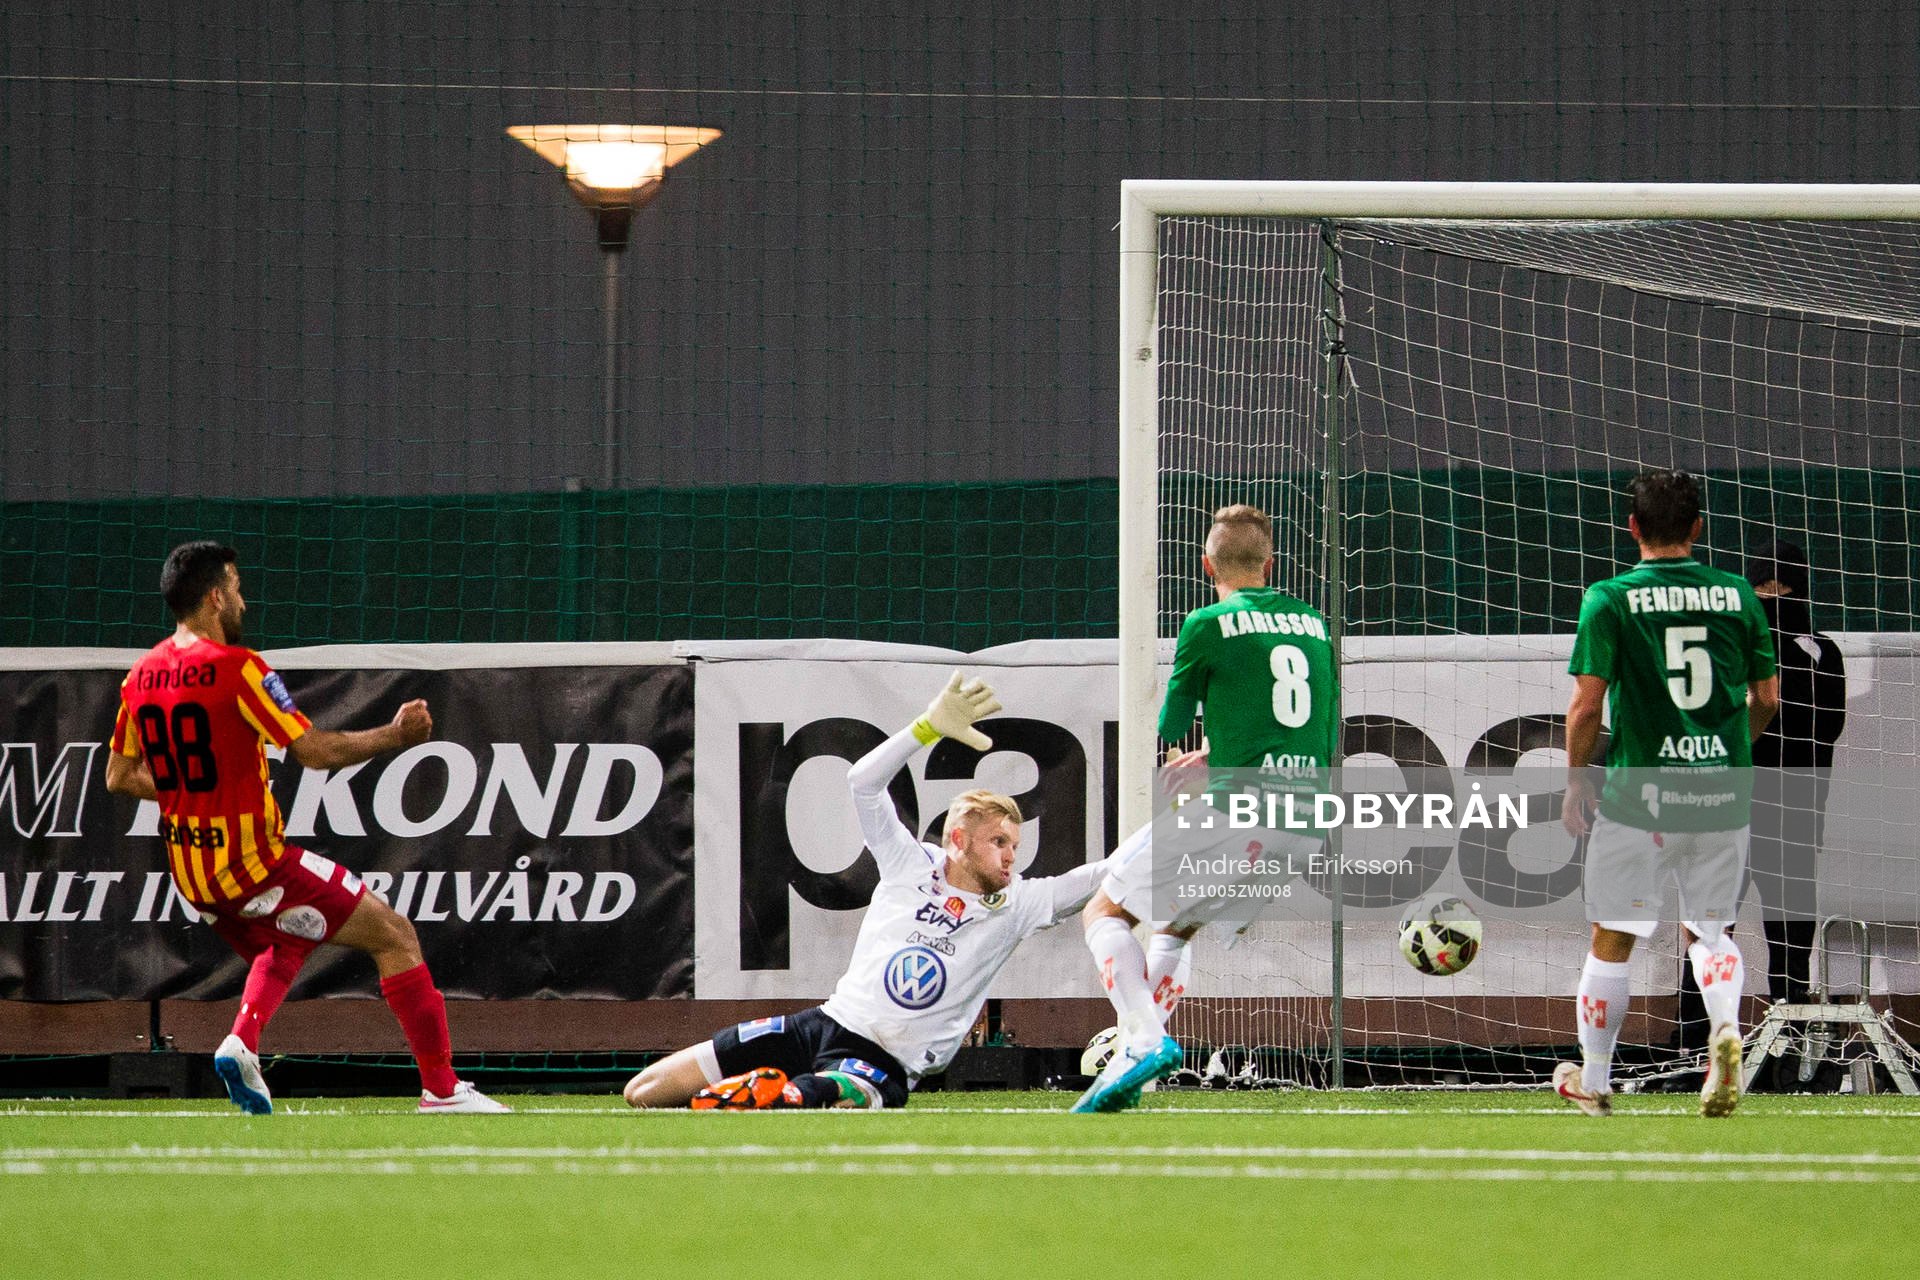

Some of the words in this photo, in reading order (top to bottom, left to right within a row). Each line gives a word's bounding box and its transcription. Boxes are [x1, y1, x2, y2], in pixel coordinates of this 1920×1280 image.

[1217, 610, 1328, 640] KARLSSON
[1626, 586, 1742, 614] FENDRICH
[1269, 644, 1311, 729] 8
[1664, 626, 1714, 711] 5
[138, 702, 218, 793] 88
[1258, 752, 1319, 780] AQUA
[1657, 734, 1729, 762] AQUA
[125, 740, 664, 838] KOND
[738, 713, 1611, 972] paea
[361, 855, 638, 922] BILVÅRD
